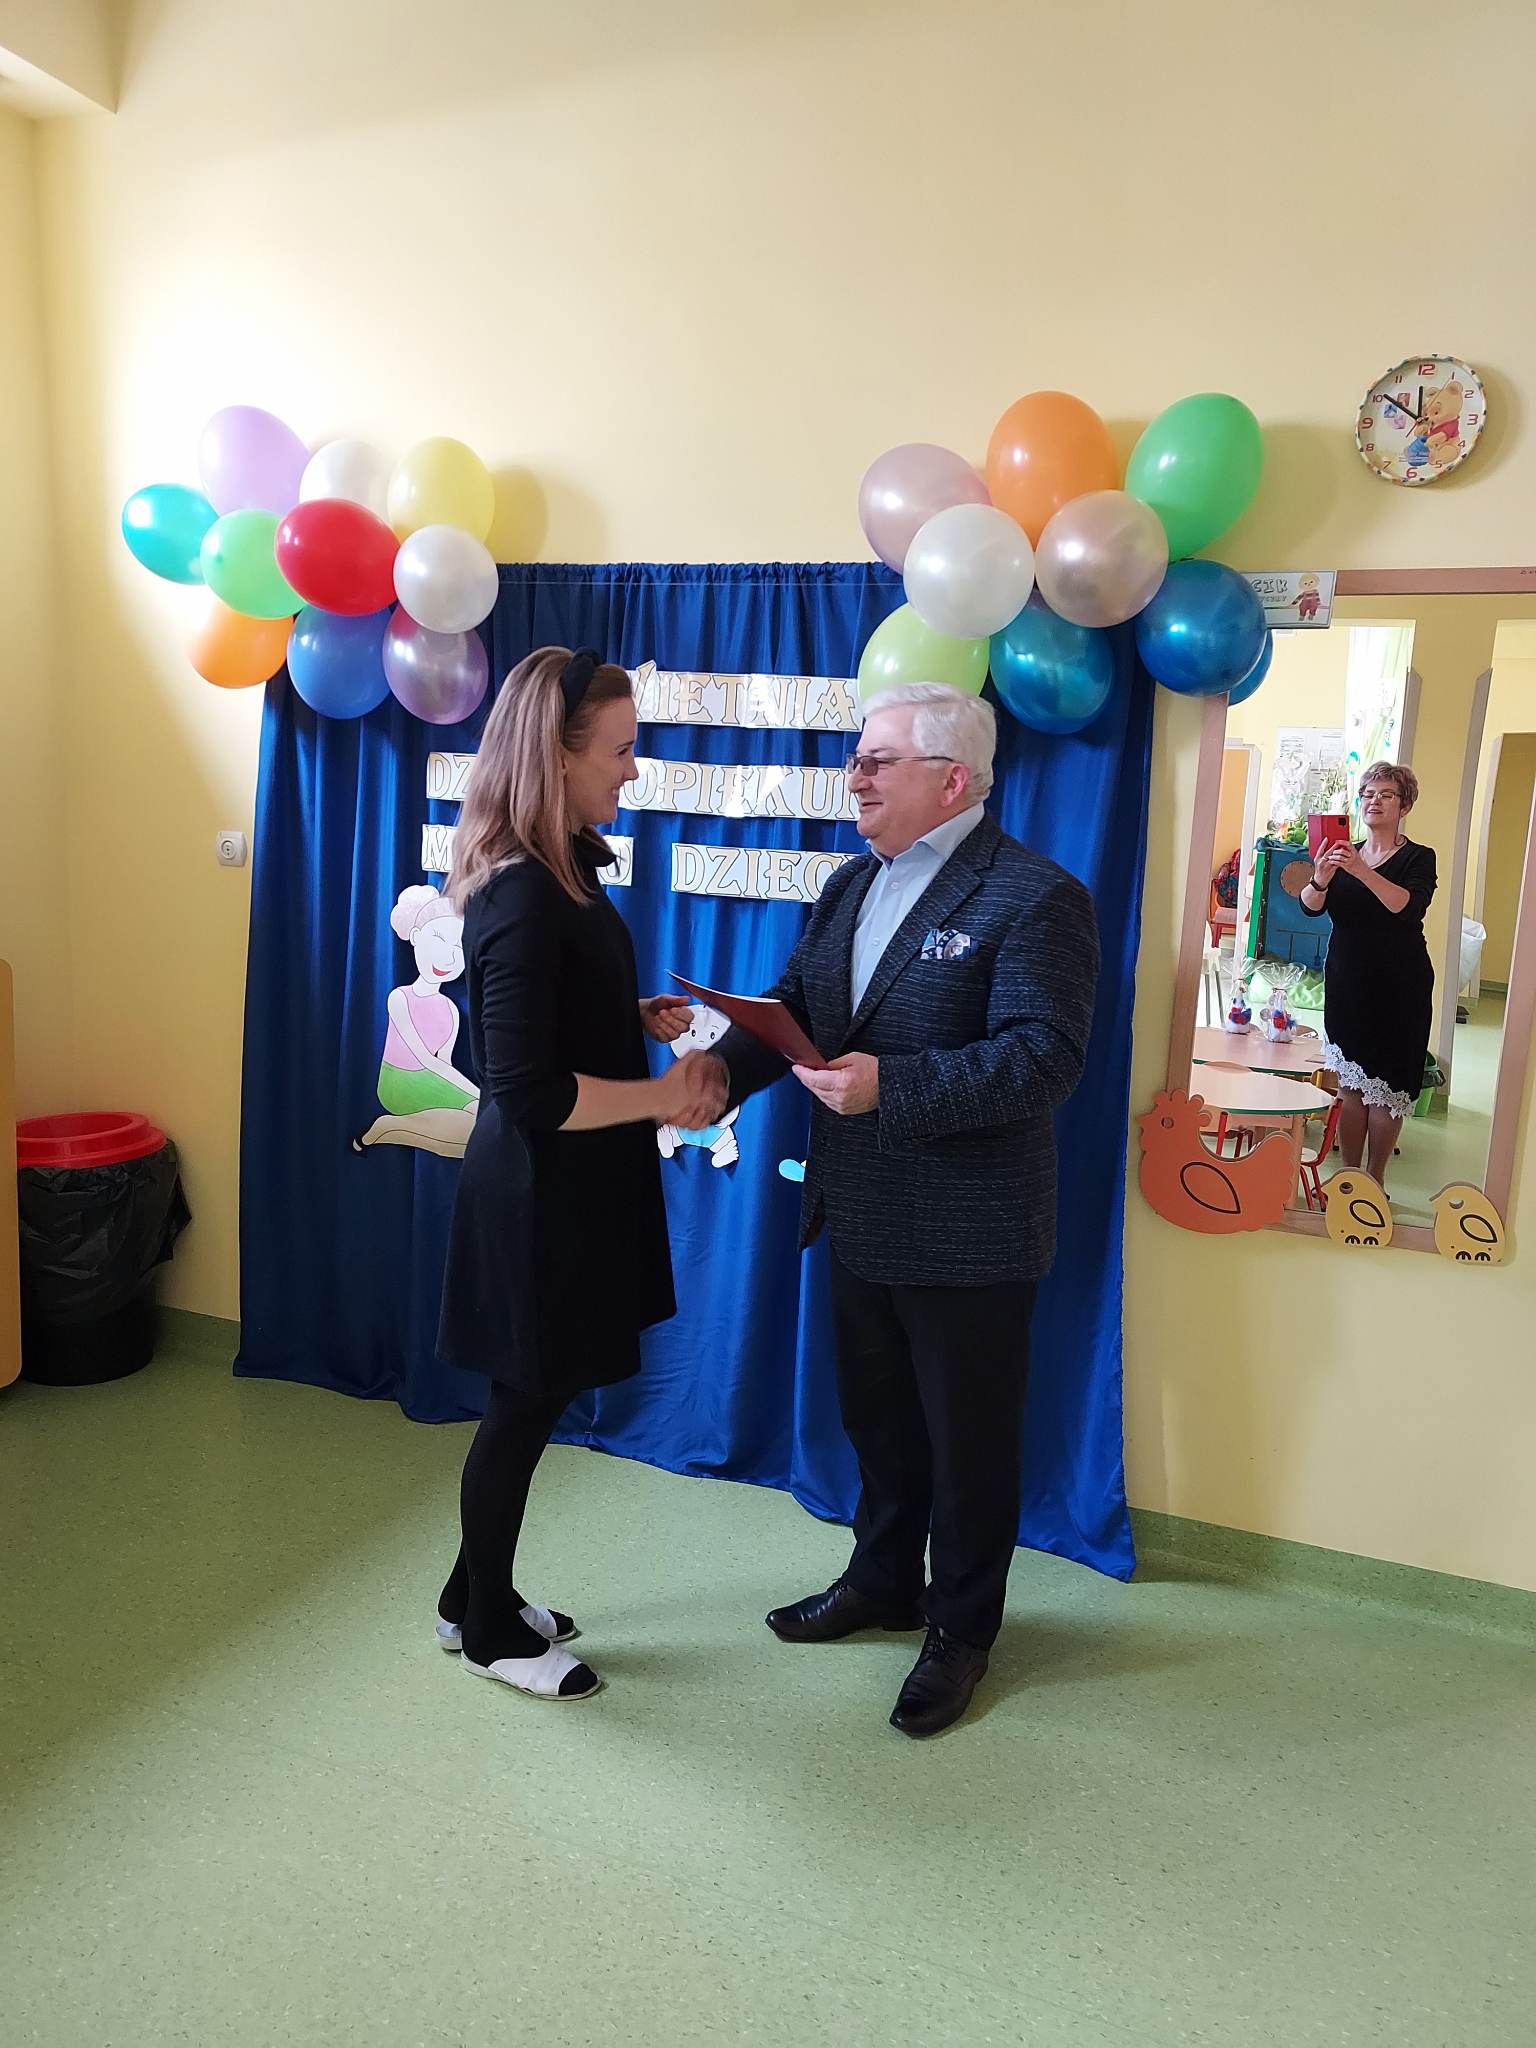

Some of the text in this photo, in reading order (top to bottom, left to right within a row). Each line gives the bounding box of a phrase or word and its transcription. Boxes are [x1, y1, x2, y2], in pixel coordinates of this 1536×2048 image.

[1417, 363, 1436, 376] 12
[1395, 375, 1403, 384] 11
[1372, 394, 1384, 403] 10
[1464, 389, 1474, 399] 2
[1361, 417, 1374, 429] 9
[1466, 413, 1479, 426] 3
[1365, 443, 1374, 452] 8
[1457, 440, 1466, 448] 4
[1383, 460, 1392, 469] 7
[1434, 460, 1443, 469] 5
[1406, 467, 1418, 479] 6
[1250, 578, 1288, 593] CIK
[673, 844, 852, 903] DZIEC
